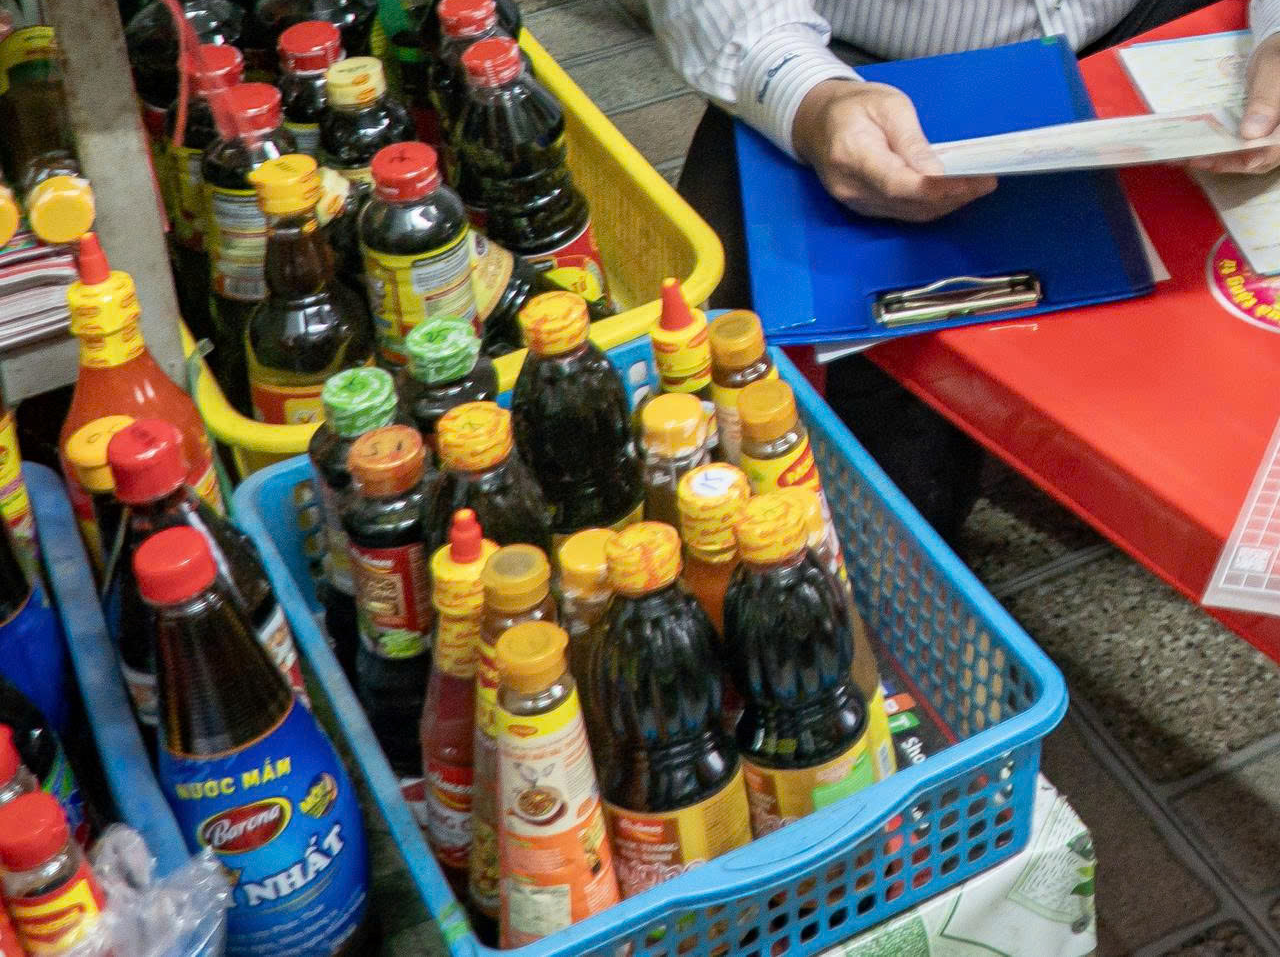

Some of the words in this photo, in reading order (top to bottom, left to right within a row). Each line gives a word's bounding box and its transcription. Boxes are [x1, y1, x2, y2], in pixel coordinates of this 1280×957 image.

[175, 775, 237, 800] NƯỚC
[241, 756, 293, 791] MẮM
[243, 823, 346, 907] NHẤT
